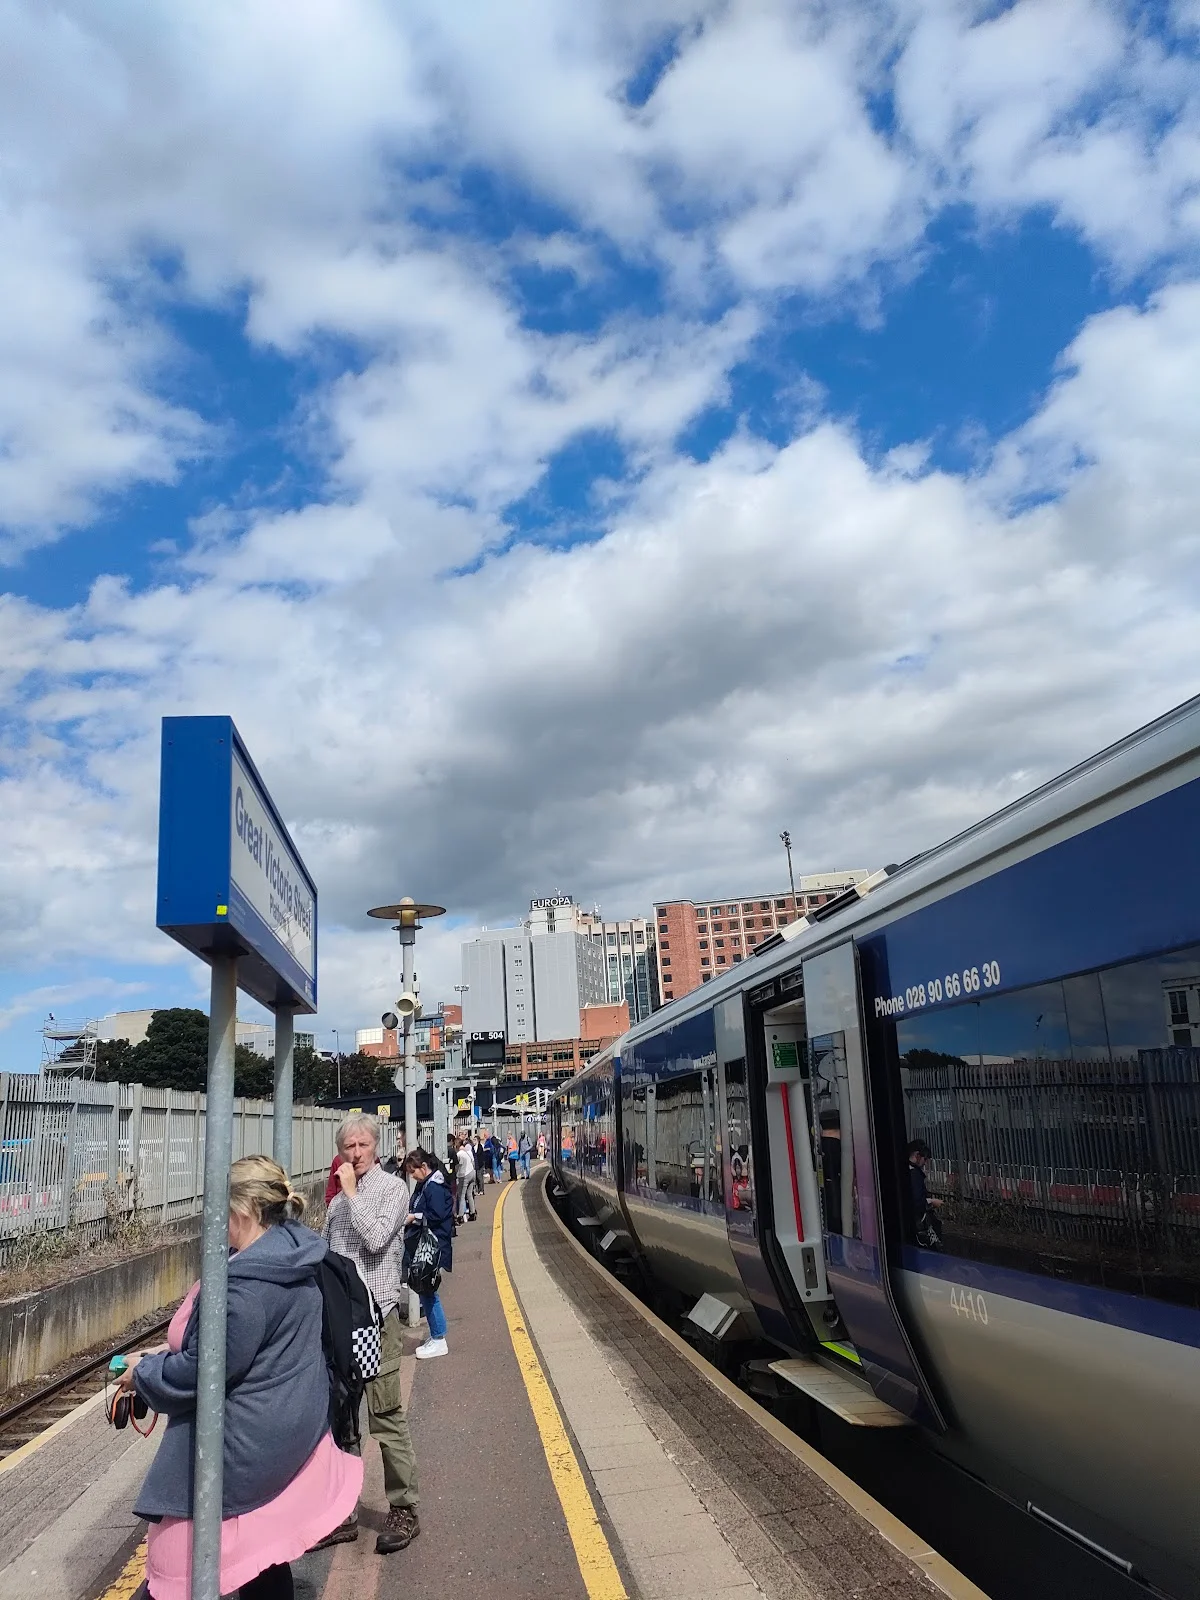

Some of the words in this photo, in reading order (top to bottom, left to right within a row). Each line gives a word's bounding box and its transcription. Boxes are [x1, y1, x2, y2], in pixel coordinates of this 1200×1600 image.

[235, 786, 263, 871] Great
[264, 834, 292, 912] Victoria
[293, 884, 311, 940] Street
[531, 897, 571, 909] EUROPA
[874, 996, 904, 1017] Phone
[905, 983, 926, 1009] 028
[928, 978, 943, 1003] 90
[945, 972, 961, 998] 66
[963, 966, 980, 993] 66
[982, 961, 1000, 987] 30
[472, 1032, 485, 1041] CL
[488, 1031, 504, 1040] 504
[950, 1287, 988, 1325] 4410
